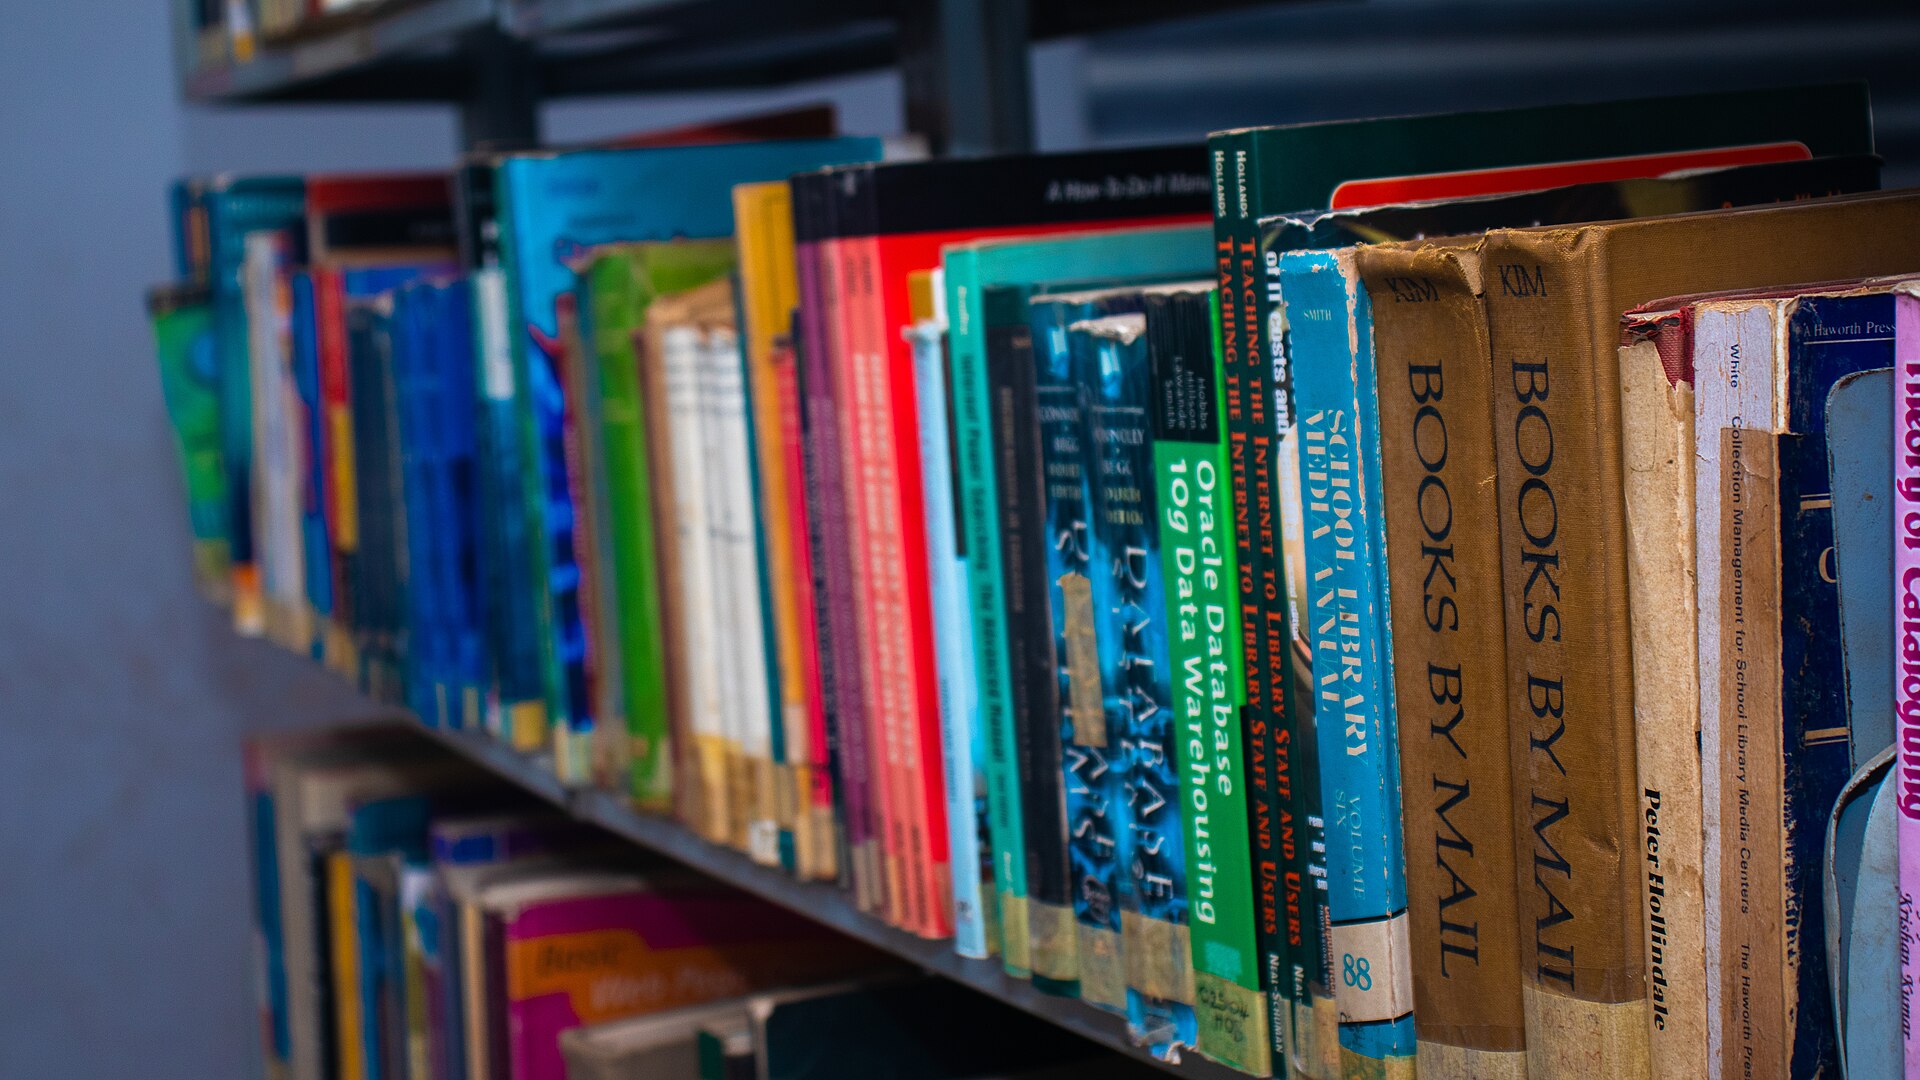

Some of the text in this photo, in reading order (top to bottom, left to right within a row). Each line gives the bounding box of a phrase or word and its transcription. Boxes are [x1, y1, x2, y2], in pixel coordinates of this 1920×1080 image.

[1213, 149, 1227, 219] HOLLANDS
[1235, 149, 1249, 220] HOLLANDS
[1304, 309, 1332, 321] SMITH
[1498, 264, 1548, 298] KIM
[1270, 311, 1288, 383] costs
[1803, 320, 1896, 337] A Haworth Press
[1174, 356, 1186, 430] Lawande
[1187, 370, 1197, 430] Hillson
[1729, 343, 1740, 389] White
[1164, 379, 1175, 430] Smith
[1198, 377, 1209, 430] Hobbs
[1275, 389, 1292, 435] and
[1731, 415, 1743, 504] Collection
[1511, 356, 1562, 643] BOOKS
[1216, 235, 1278, 935] TEACHING THE INTERNET TO LIBRARY STAFF AND USERS
[1240, 236, 1302, 946] TEACHING THE INTERNET TO LIBRARY STAFF AND USERS
[1305, 408, 1342, 713] MEDIA ANNUAL
[1328, 409, 1369, 767] SCHOOL LIBRARY
[1731, 510, 1744, 626] Management
[1197, 459, 1233, 796] Oracle Database
[1734, 629, 1745, 649] for
[1168, 458, 1218, 924] 10g Data Warehousing
[1408, 358, 1480, 979] BOOKS BY MAIL
[1735, 659, 1748, 722] School
[1125, 545, 1175, 900] DATABASE
[1527, 672, 1567, 777] BY
[1735, 724, 1748, 783] Library
[1335, 789, 1347, 827] SIX
[1739, 788, 1750, 842] Media
[1350, 794, 1366, 901] VOLUME
[1740, 848, 1752, 915] Centers
[1531, 787, 1576, 992] MAIL
[1643, 787, 1670, 1032] Peter Hollindale
[1343, 953, 1373, 992] 88
[1740, 942, 1751, 970] The
[1899, 892, 1915, 1041] Krishan Kumar
[1269, 953, 1285, 1053] NEAL-SCHUMAN
[1741, 974, 1753, 1040] Haworth
